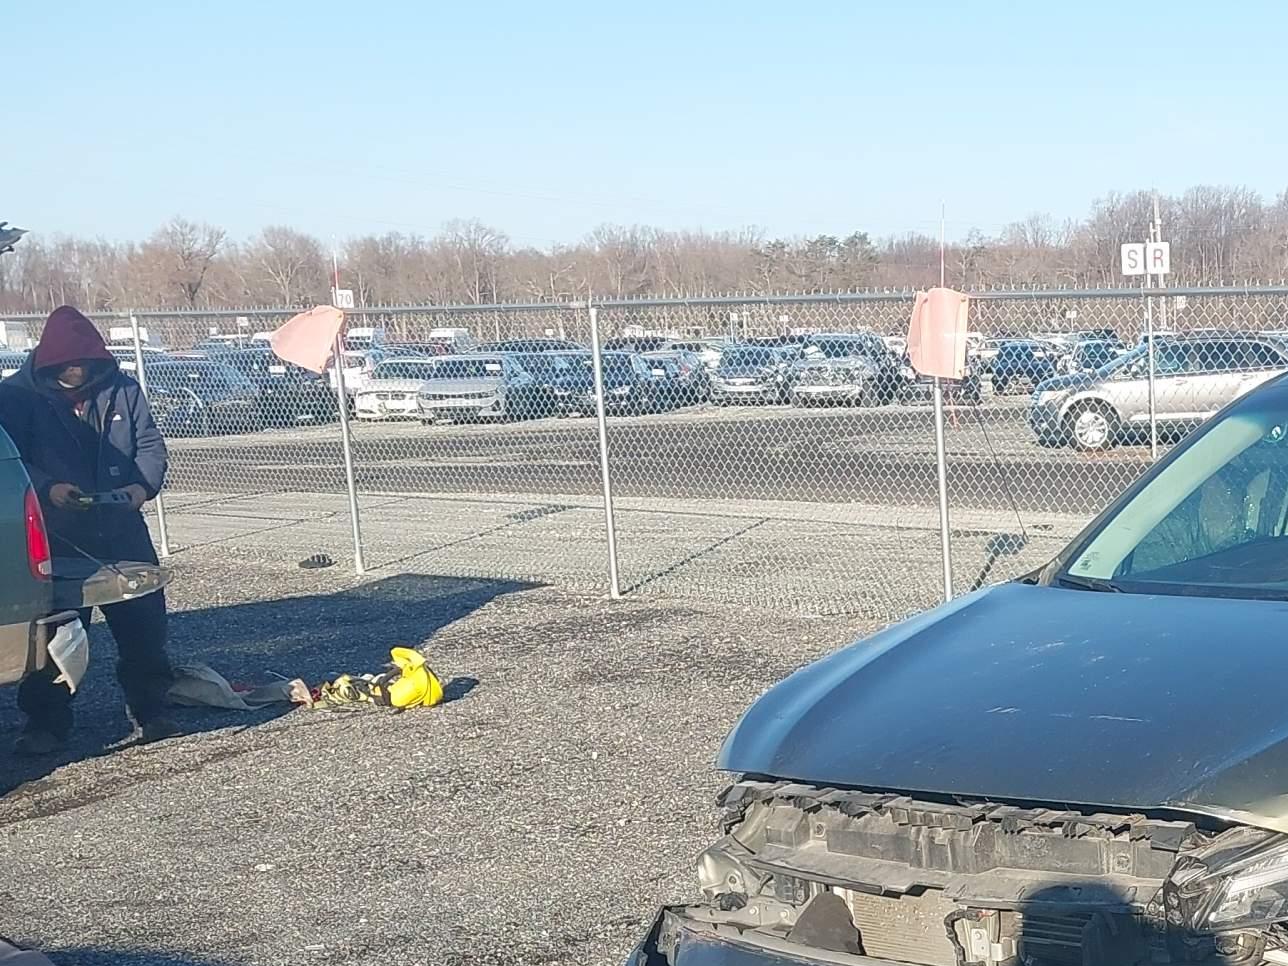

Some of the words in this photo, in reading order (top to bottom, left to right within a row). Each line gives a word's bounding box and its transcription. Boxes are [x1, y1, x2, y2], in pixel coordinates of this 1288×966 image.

[1127, 248, 1139, 269] S
[1152, 247, 1165, 268] R
[338, 293, 352, 305] 70
